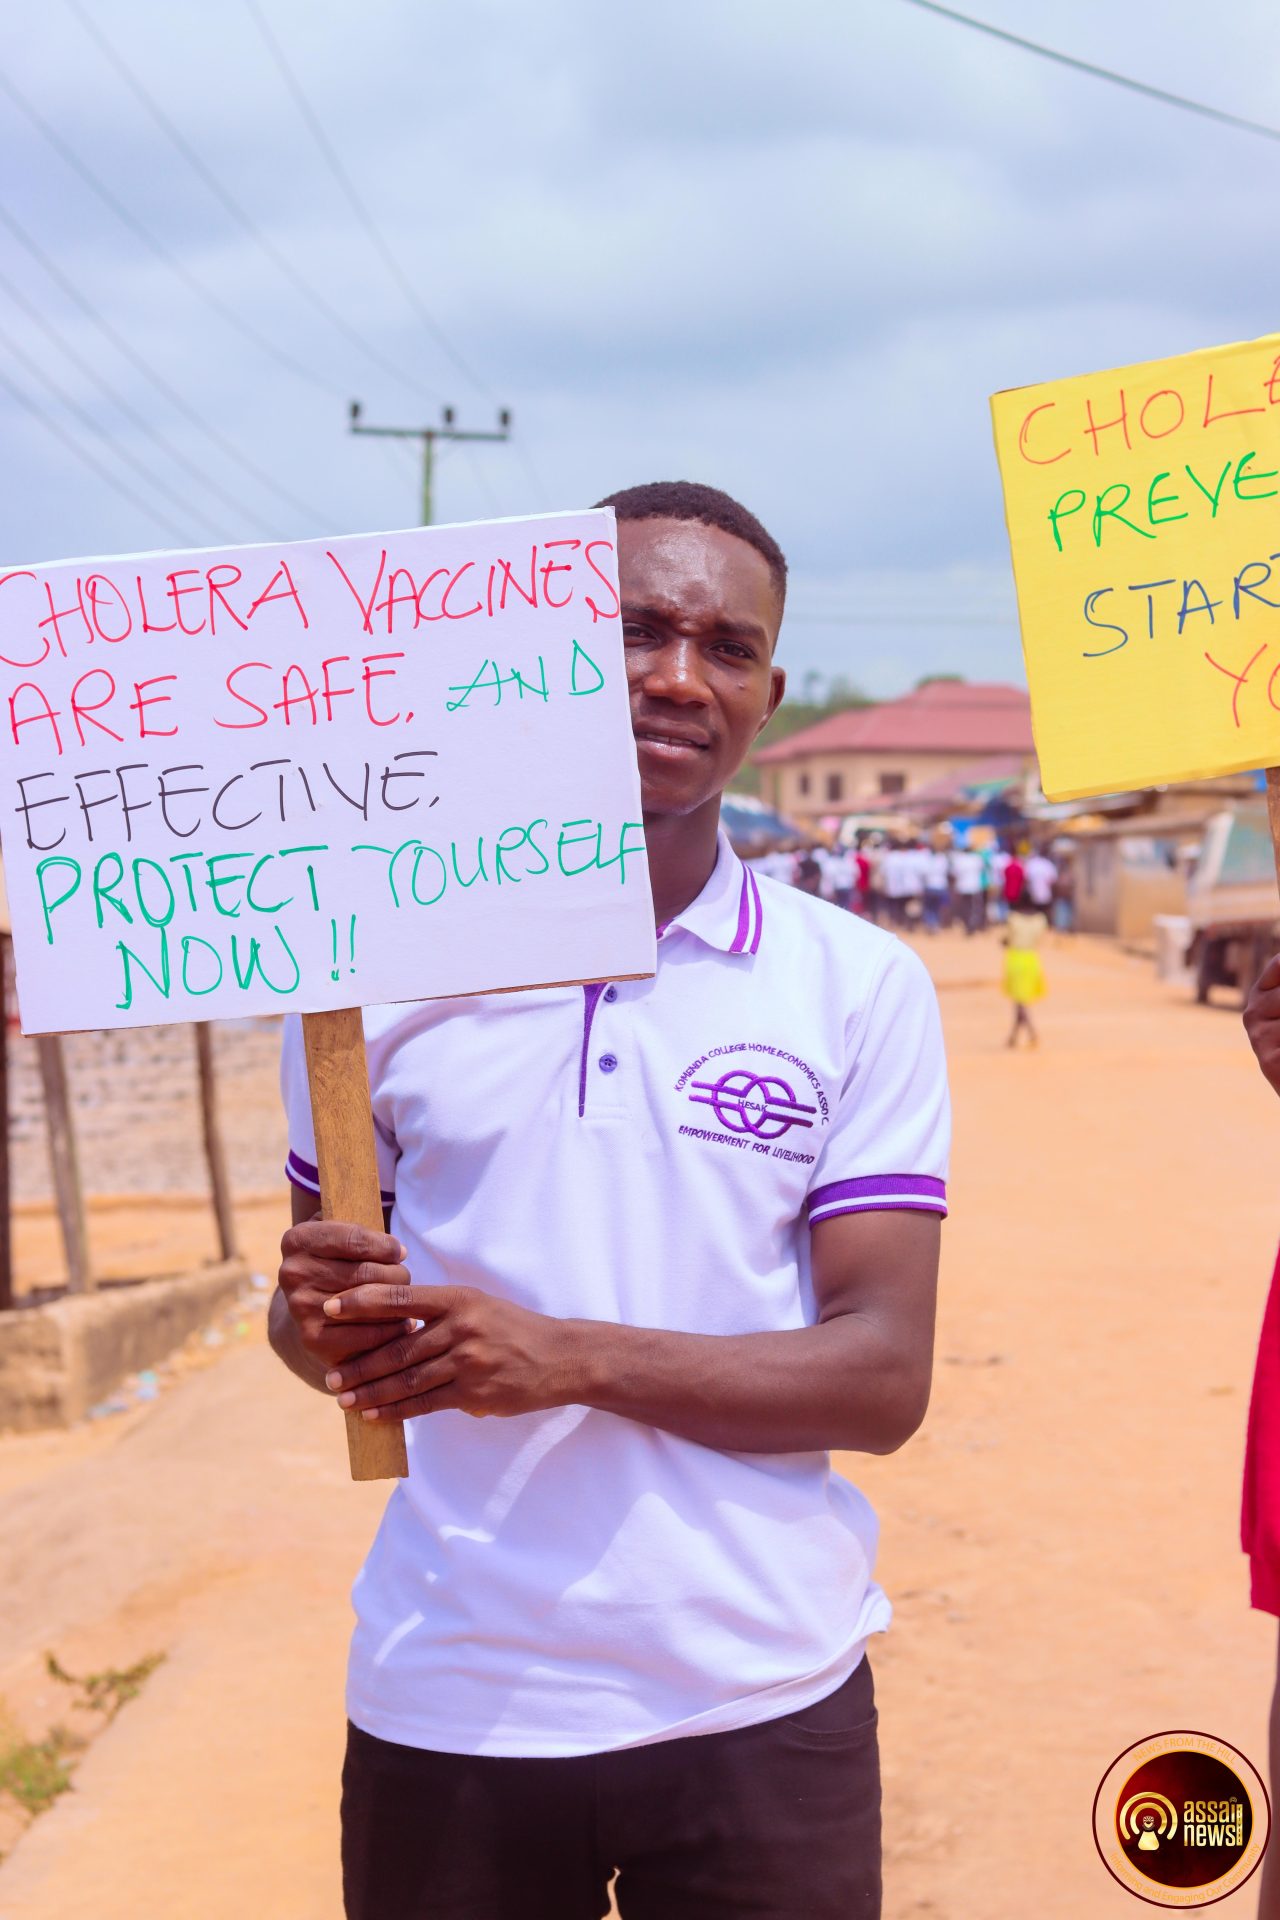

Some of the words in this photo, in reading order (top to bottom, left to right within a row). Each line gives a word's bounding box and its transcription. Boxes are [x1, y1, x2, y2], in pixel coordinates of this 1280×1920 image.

[0, 561, 309, 667] CHOLERA
[326, 539, 622, 635] VACCINES
[1083, 552, 1280, 657] STAR
[8, 668, 178, 755] ARE
[446, 640, 606, 711] AND
[36, 845, 328, 945] PROTECT
[674, 1055, 709, 1092] KOMENDA
[708, 1043, 747, 1058] COLLEGE
[748, 1042, 777, 1056] HOME
[776, 1049, 821, 1090] ECONOMICS
[678, 1125, 750, 1149] EMPOWERMENT
[751, 1142, 771, 1156] FOR
[772, 1146, 816, 1165] LIVELIHOOD
